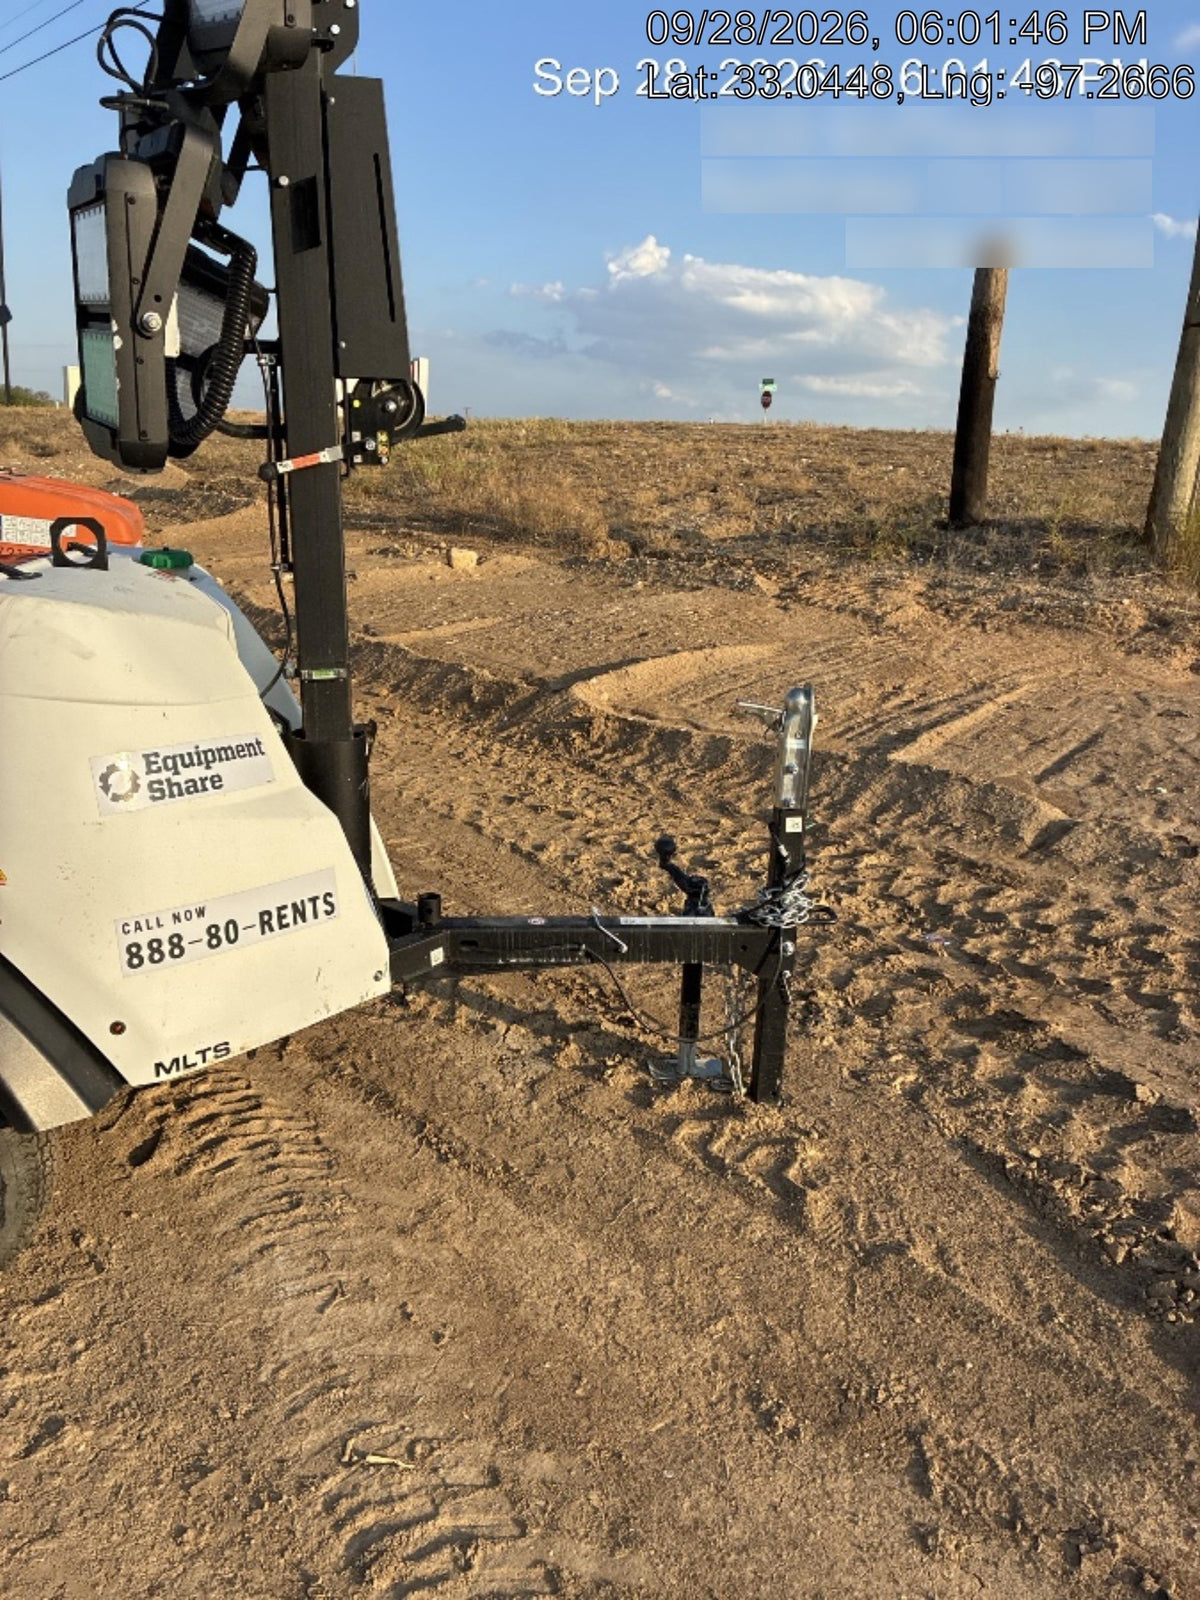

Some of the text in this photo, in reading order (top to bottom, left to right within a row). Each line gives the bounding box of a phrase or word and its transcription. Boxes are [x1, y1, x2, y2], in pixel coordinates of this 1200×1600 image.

[142, 737, 266, 776] Equipment
[147, 773, 224, 802] Share
[121, 905, 207, 935] CALL NOW
[125, 892, 336, 970] 888-80-RENTS
[153, 1041, 232, 1078] MLTS
